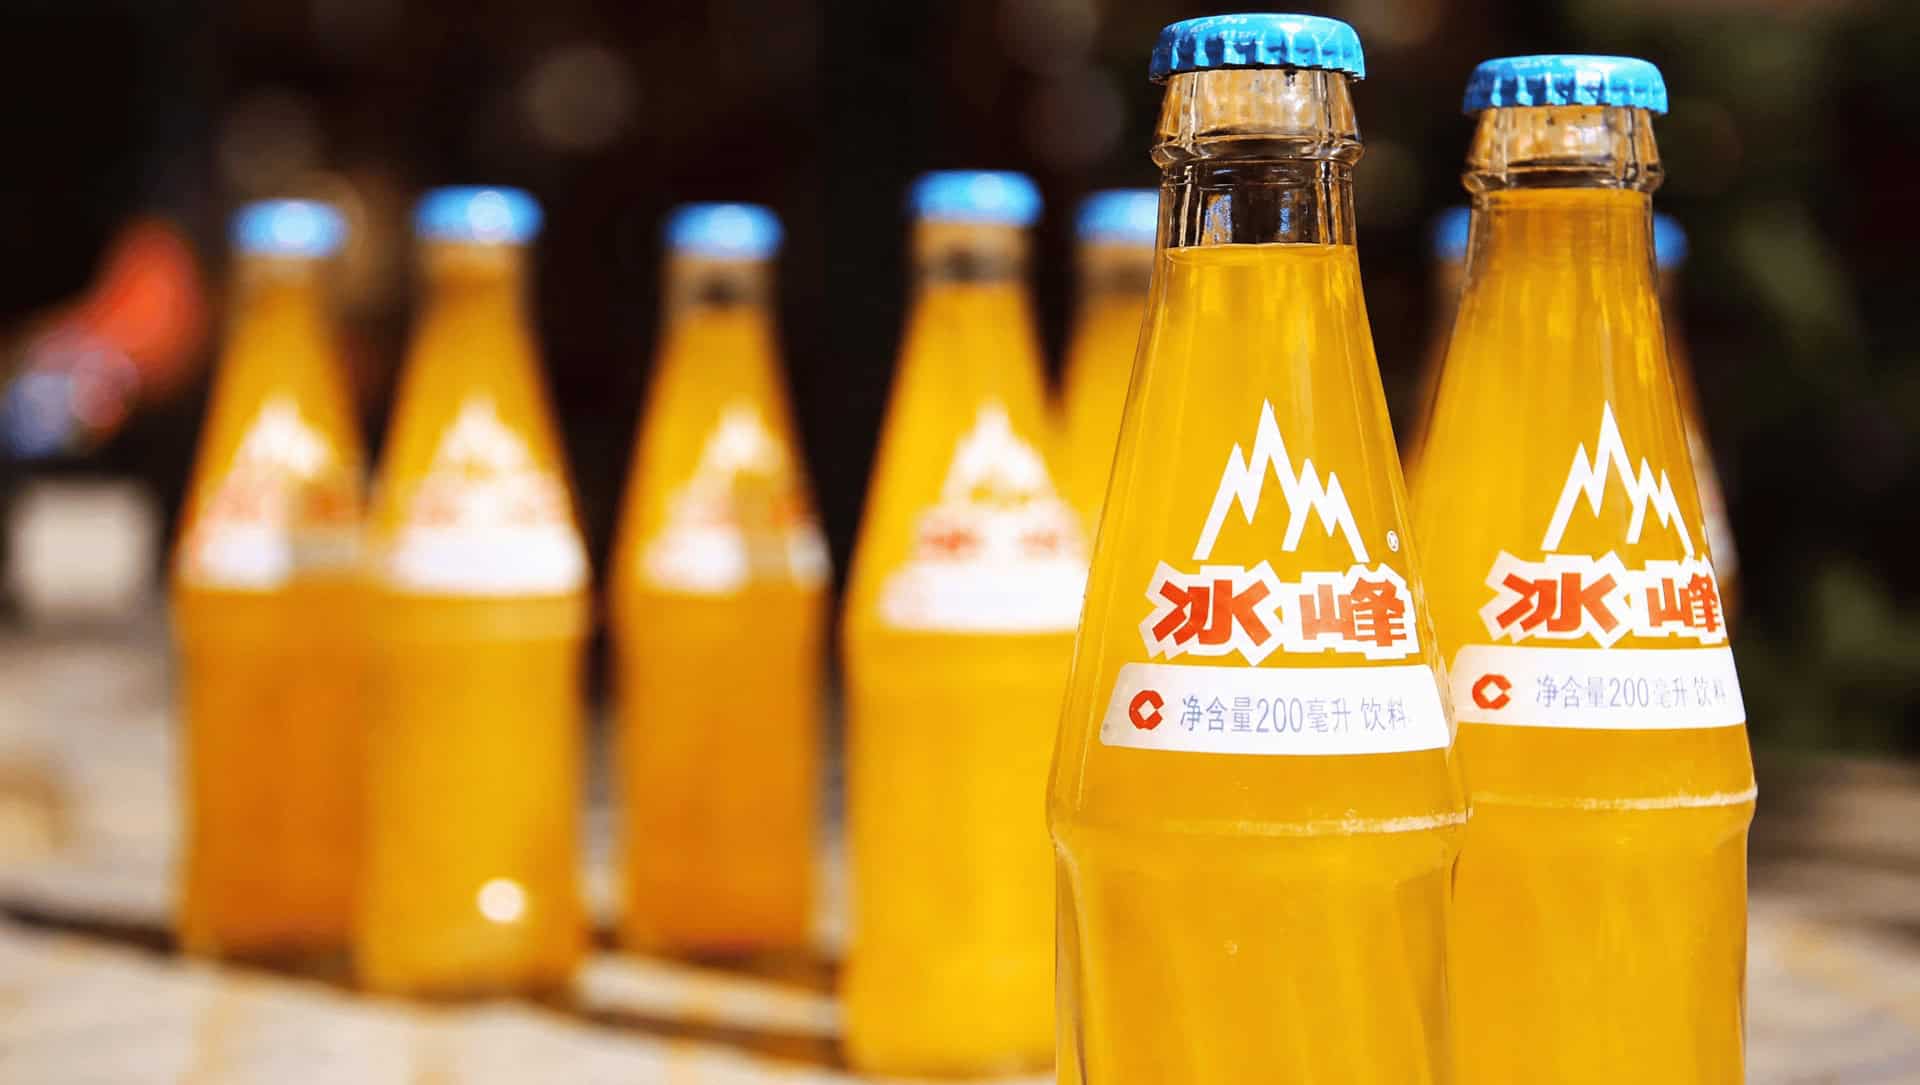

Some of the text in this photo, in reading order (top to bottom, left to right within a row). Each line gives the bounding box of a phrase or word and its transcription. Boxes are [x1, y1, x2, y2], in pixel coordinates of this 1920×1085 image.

[1149, 574, 1409, 650] 冰峰
[1494, 570, 1723, 635] 冰峰
[1179, 694, 1352, 734] 净含量200毫升
